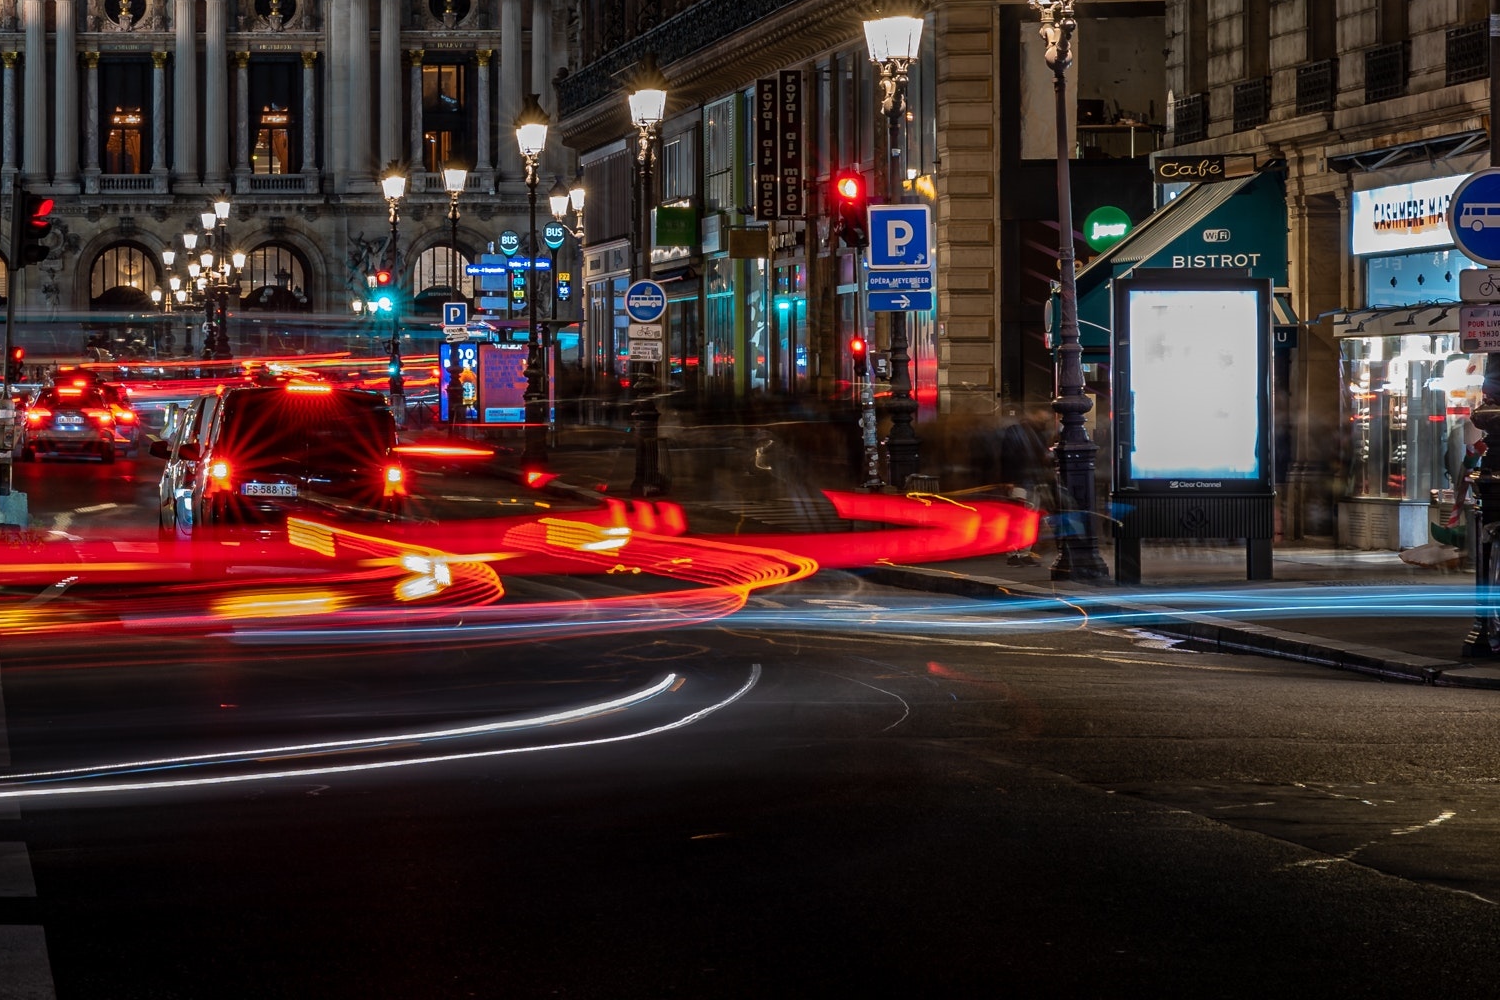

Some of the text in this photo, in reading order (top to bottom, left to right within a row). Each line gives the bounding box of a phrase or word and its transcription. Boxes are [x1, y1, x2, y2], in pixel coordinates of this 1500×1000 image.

[760, 83, 775, 216] royal air maroc
[784, 75, 798, 211] royal air maroc
[1160, 159, 1222, 178] Café
[1373, 199, 1425, 230] CASHMERE
[546, 228, 562, 237] BUS
[887, 220, 914, 257] P
[501, 236, 517, 245] BUS
[1172, 253, 1261, 268] BISTROT
[870, 276, 890, 285] OPÉRA
[450, 307, 461, 322] P
[246, 485, 291, 495] FS-588-YS
